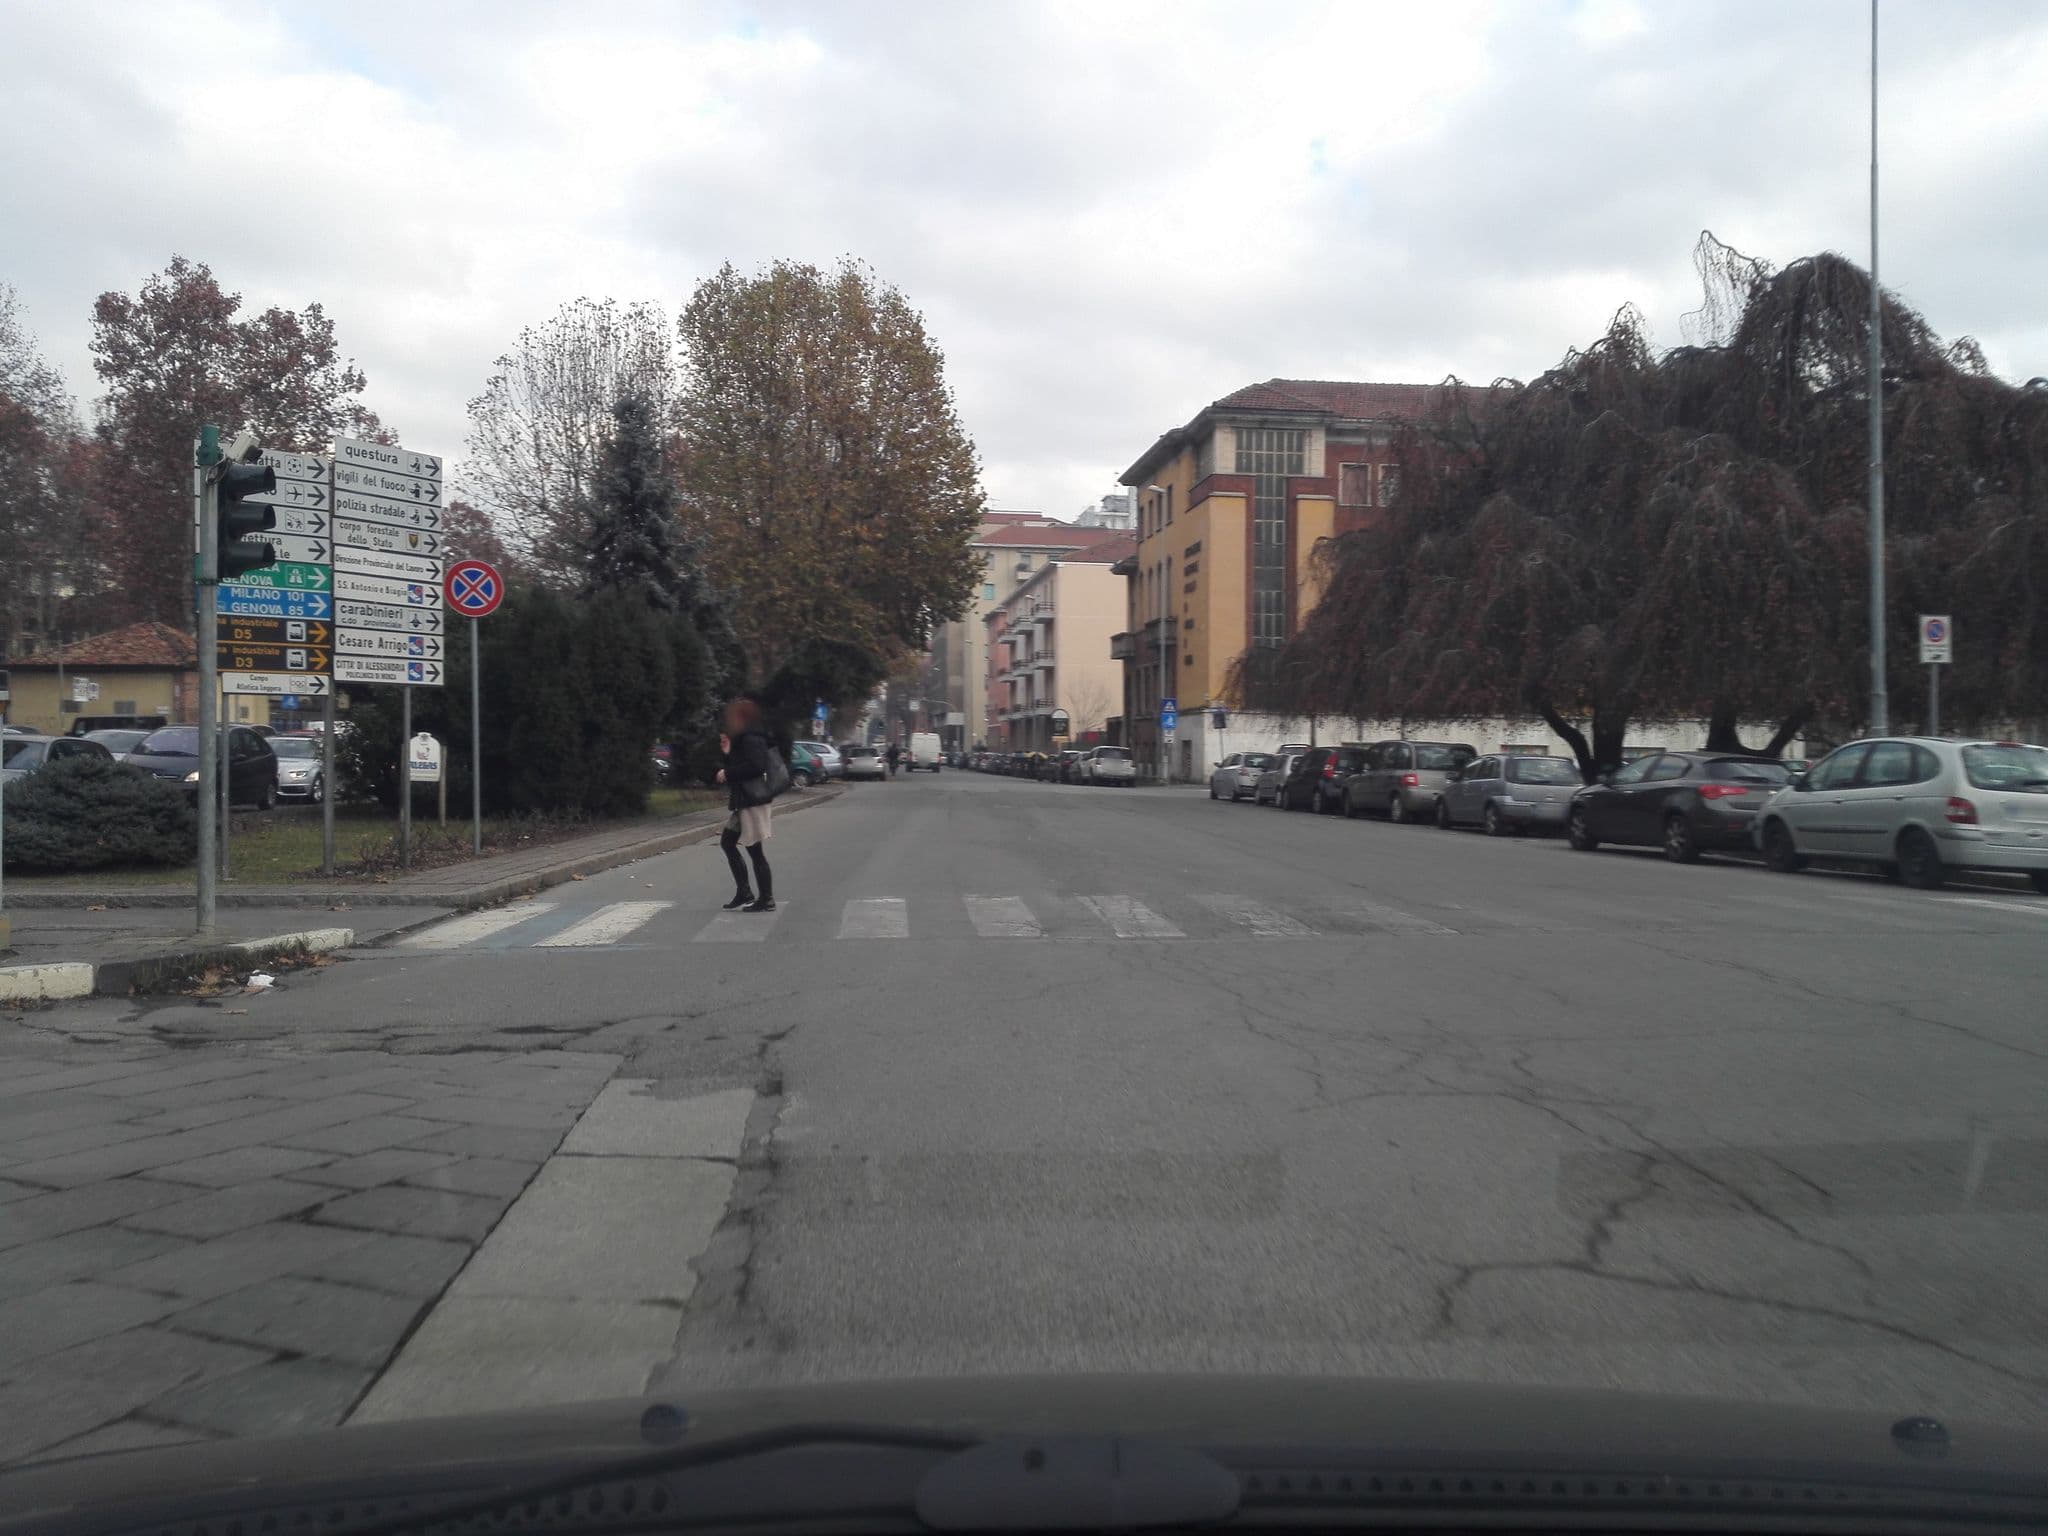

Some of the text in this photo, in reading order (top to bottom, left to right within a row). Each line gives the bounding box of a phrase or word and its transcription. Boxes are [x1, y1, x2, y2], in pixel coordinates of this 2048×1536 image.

[345, 445, 398, 465] questura
[336, 469, 406, 492] vigili del fuoco
[336, 498, 406, 518] polizia stradale
[339, 521, 400, 537] corpo forestale
[347, 534, 393, 548] dello Stato
[335, 553, 361, 565] Direzione
[363, 557, 394, 569] Provinciale
[396, 562, 405, 571] del
[231, 587, 304, 601] MILANO 101
[350, 582, 378, 593] Antonio
[231, 602, 283, 615] GENOVA
[288, 605, 304, 616] 85
[340, 604, 403, 619] carabinieri
[230, 617, 280, 628] industriale
[363, 619, 402, 628] provinciale
[234, 628, 252, 639] D5
[338, 633, 408, 653] Cesare Arrigo
[232, 647, 281, 656] industriale
[235, 657, 254, 668] D3
[357, 661, 364, 670] DI
[365, 662, 405, 672] ALESSANDRIA
[249, 674, 269, 682] Campo
